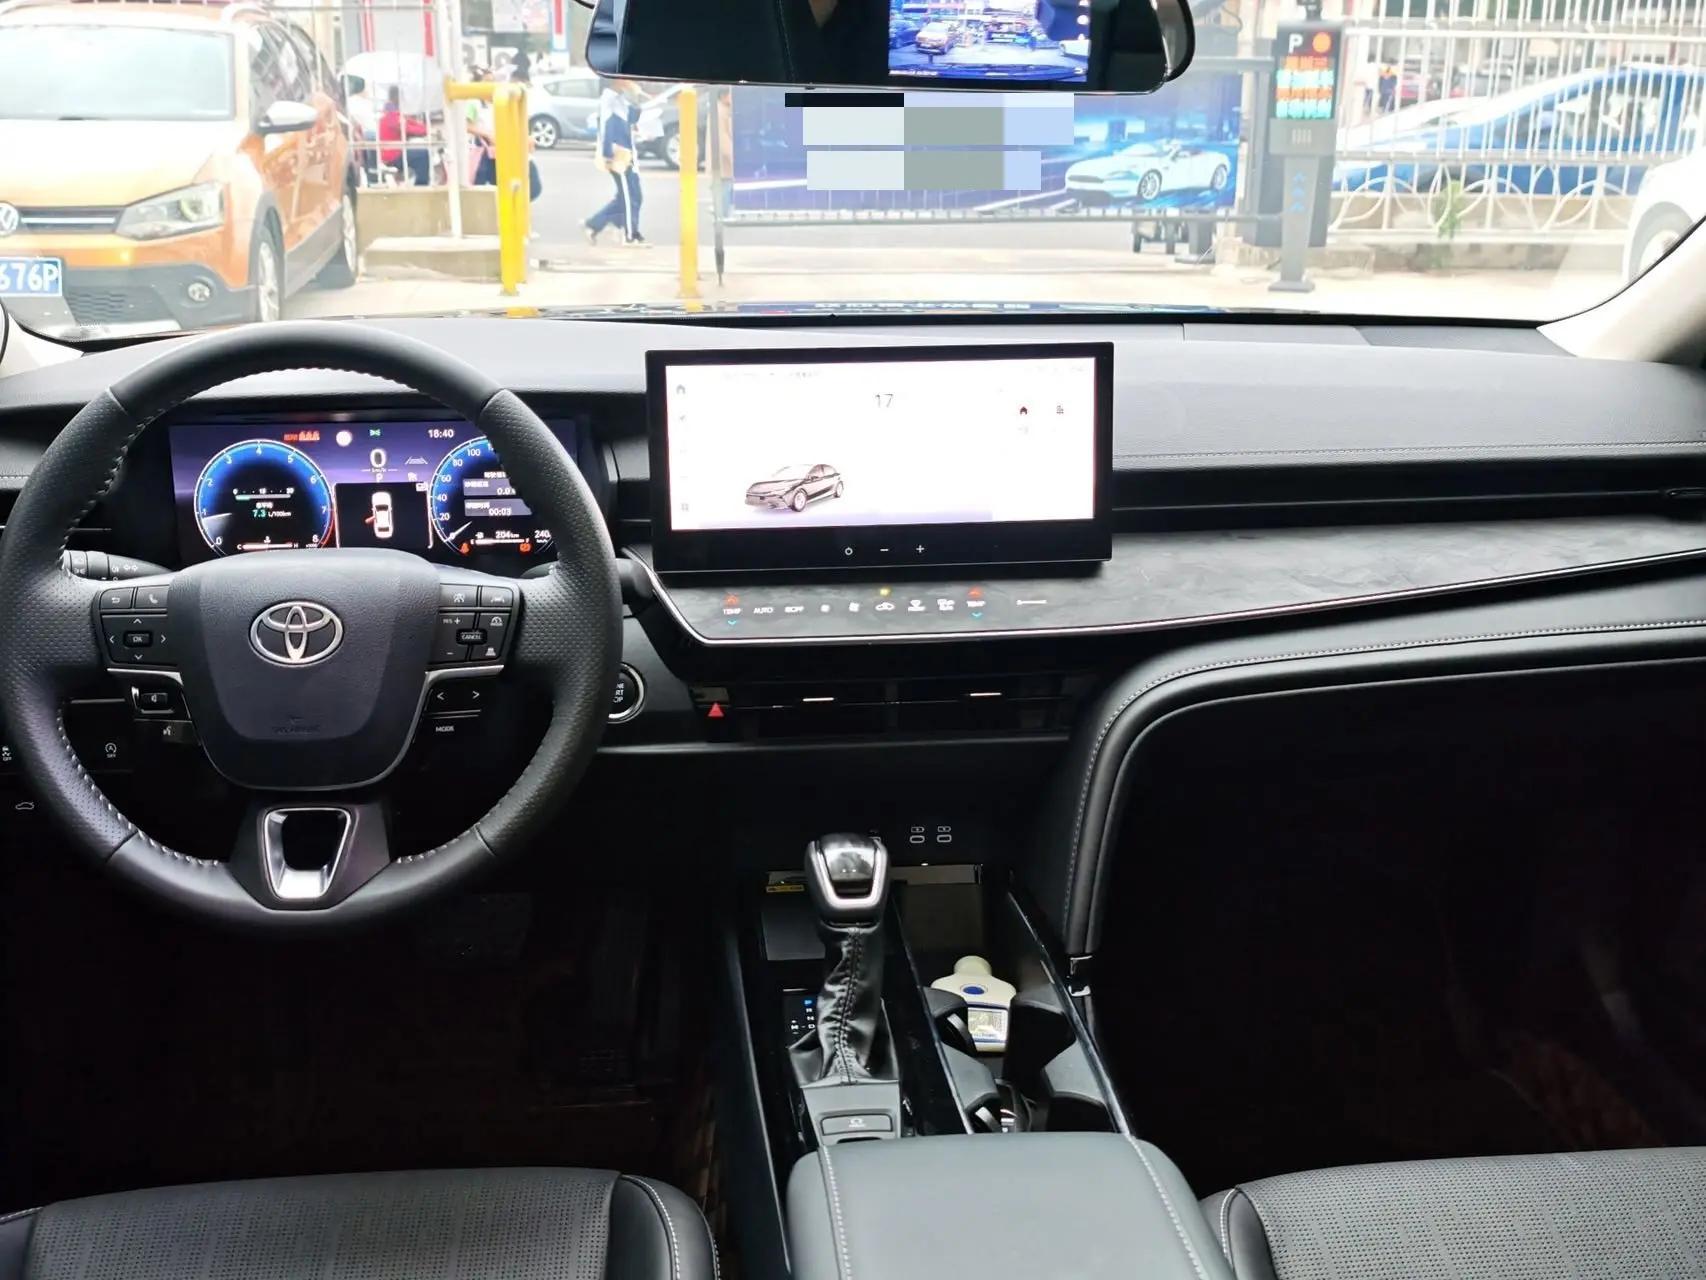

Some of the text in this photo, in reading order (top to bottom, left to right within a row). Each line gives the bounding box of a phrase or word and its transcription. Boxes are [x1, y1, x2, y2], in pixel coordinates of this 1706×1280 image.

[1289, 33, 1303, 54] P
[428, 429, 454, 438] 18:40
[467, 448, 481, 457] 100
[225, 455, 232, 464] 3
[287, 455, 294, 463] 5
[370, 448, 386, 468] 0
[452, 459, 463, 467] 80
[310, 476, 317, 484] 6
[376, 473, 383, 483] P
[441, 474, 452, 483] 60
[207, 479, 213, 487] 2
[437, 493, 448, 502] 40
[252, 509, 266, 518] 7.3
[322, 506, 328, 514] 7
[488, 507, 513, 516] 00:03
[439, 513, 450, 521] 20
[312, 534, 320, 543] 8
[534, 530, 549, 538] 240
[216, 536, 223, 545] 0
[753, 606, 774, 614] AUTO
